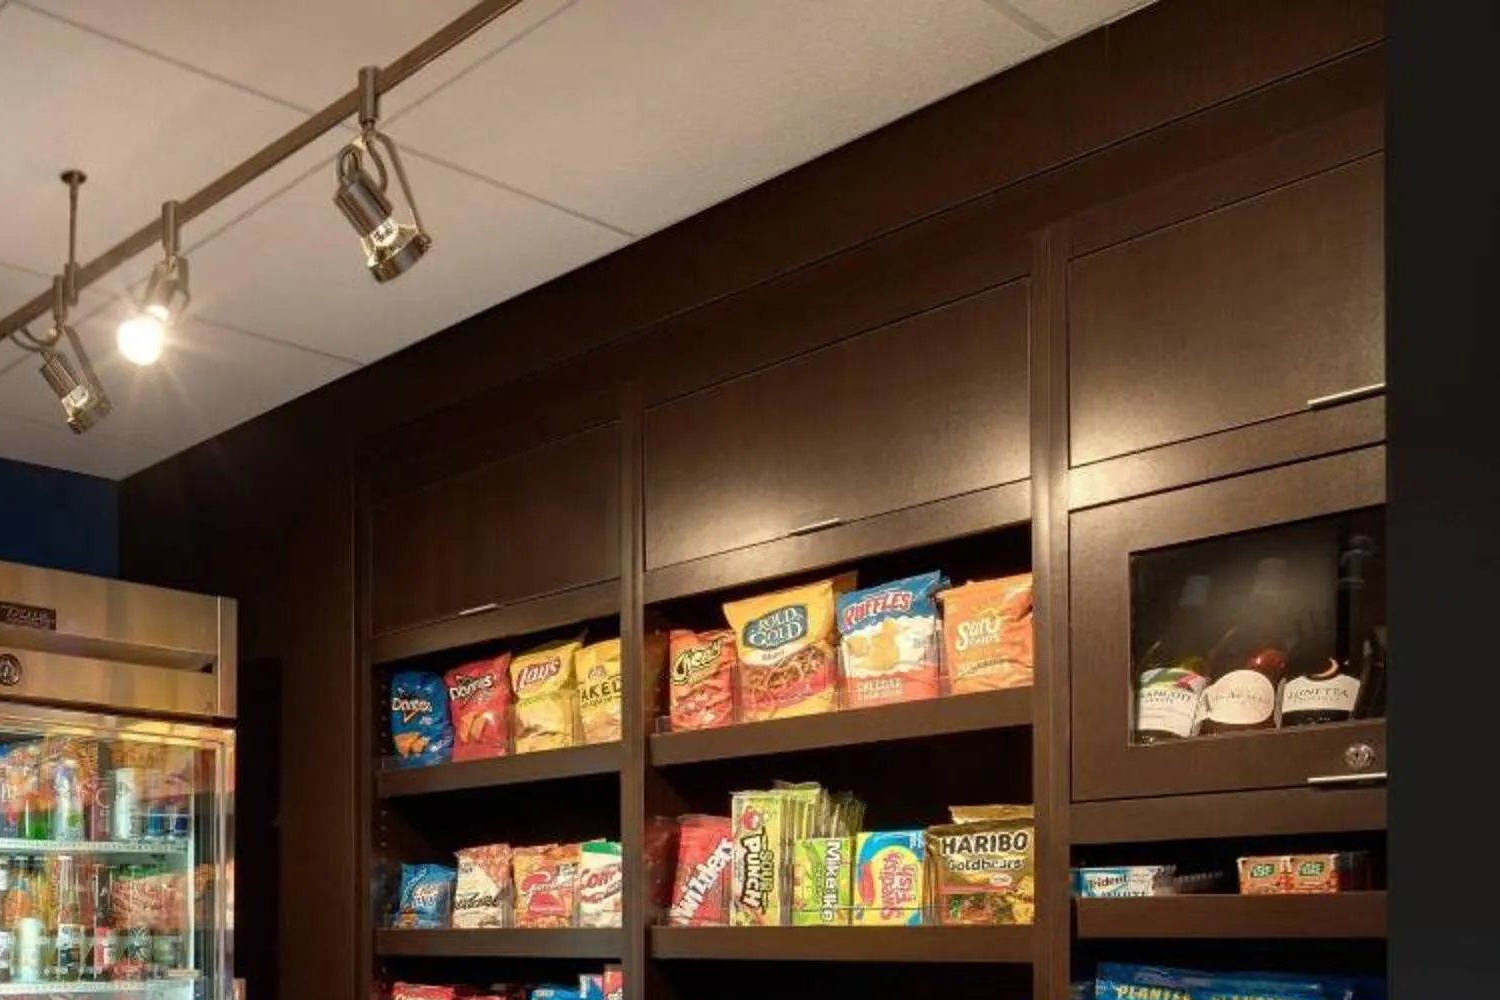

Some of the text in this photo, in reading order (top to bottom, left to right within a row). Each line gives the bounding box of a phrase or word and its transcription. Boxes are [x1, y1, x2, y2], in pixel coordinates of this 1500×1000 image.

[579, 678, 622, 702] AKED
[941, 831, 1029, 855] HARIBO
[742, 835, 763, 909] PUNCH
[759, 850, 774, 893] SOUR
